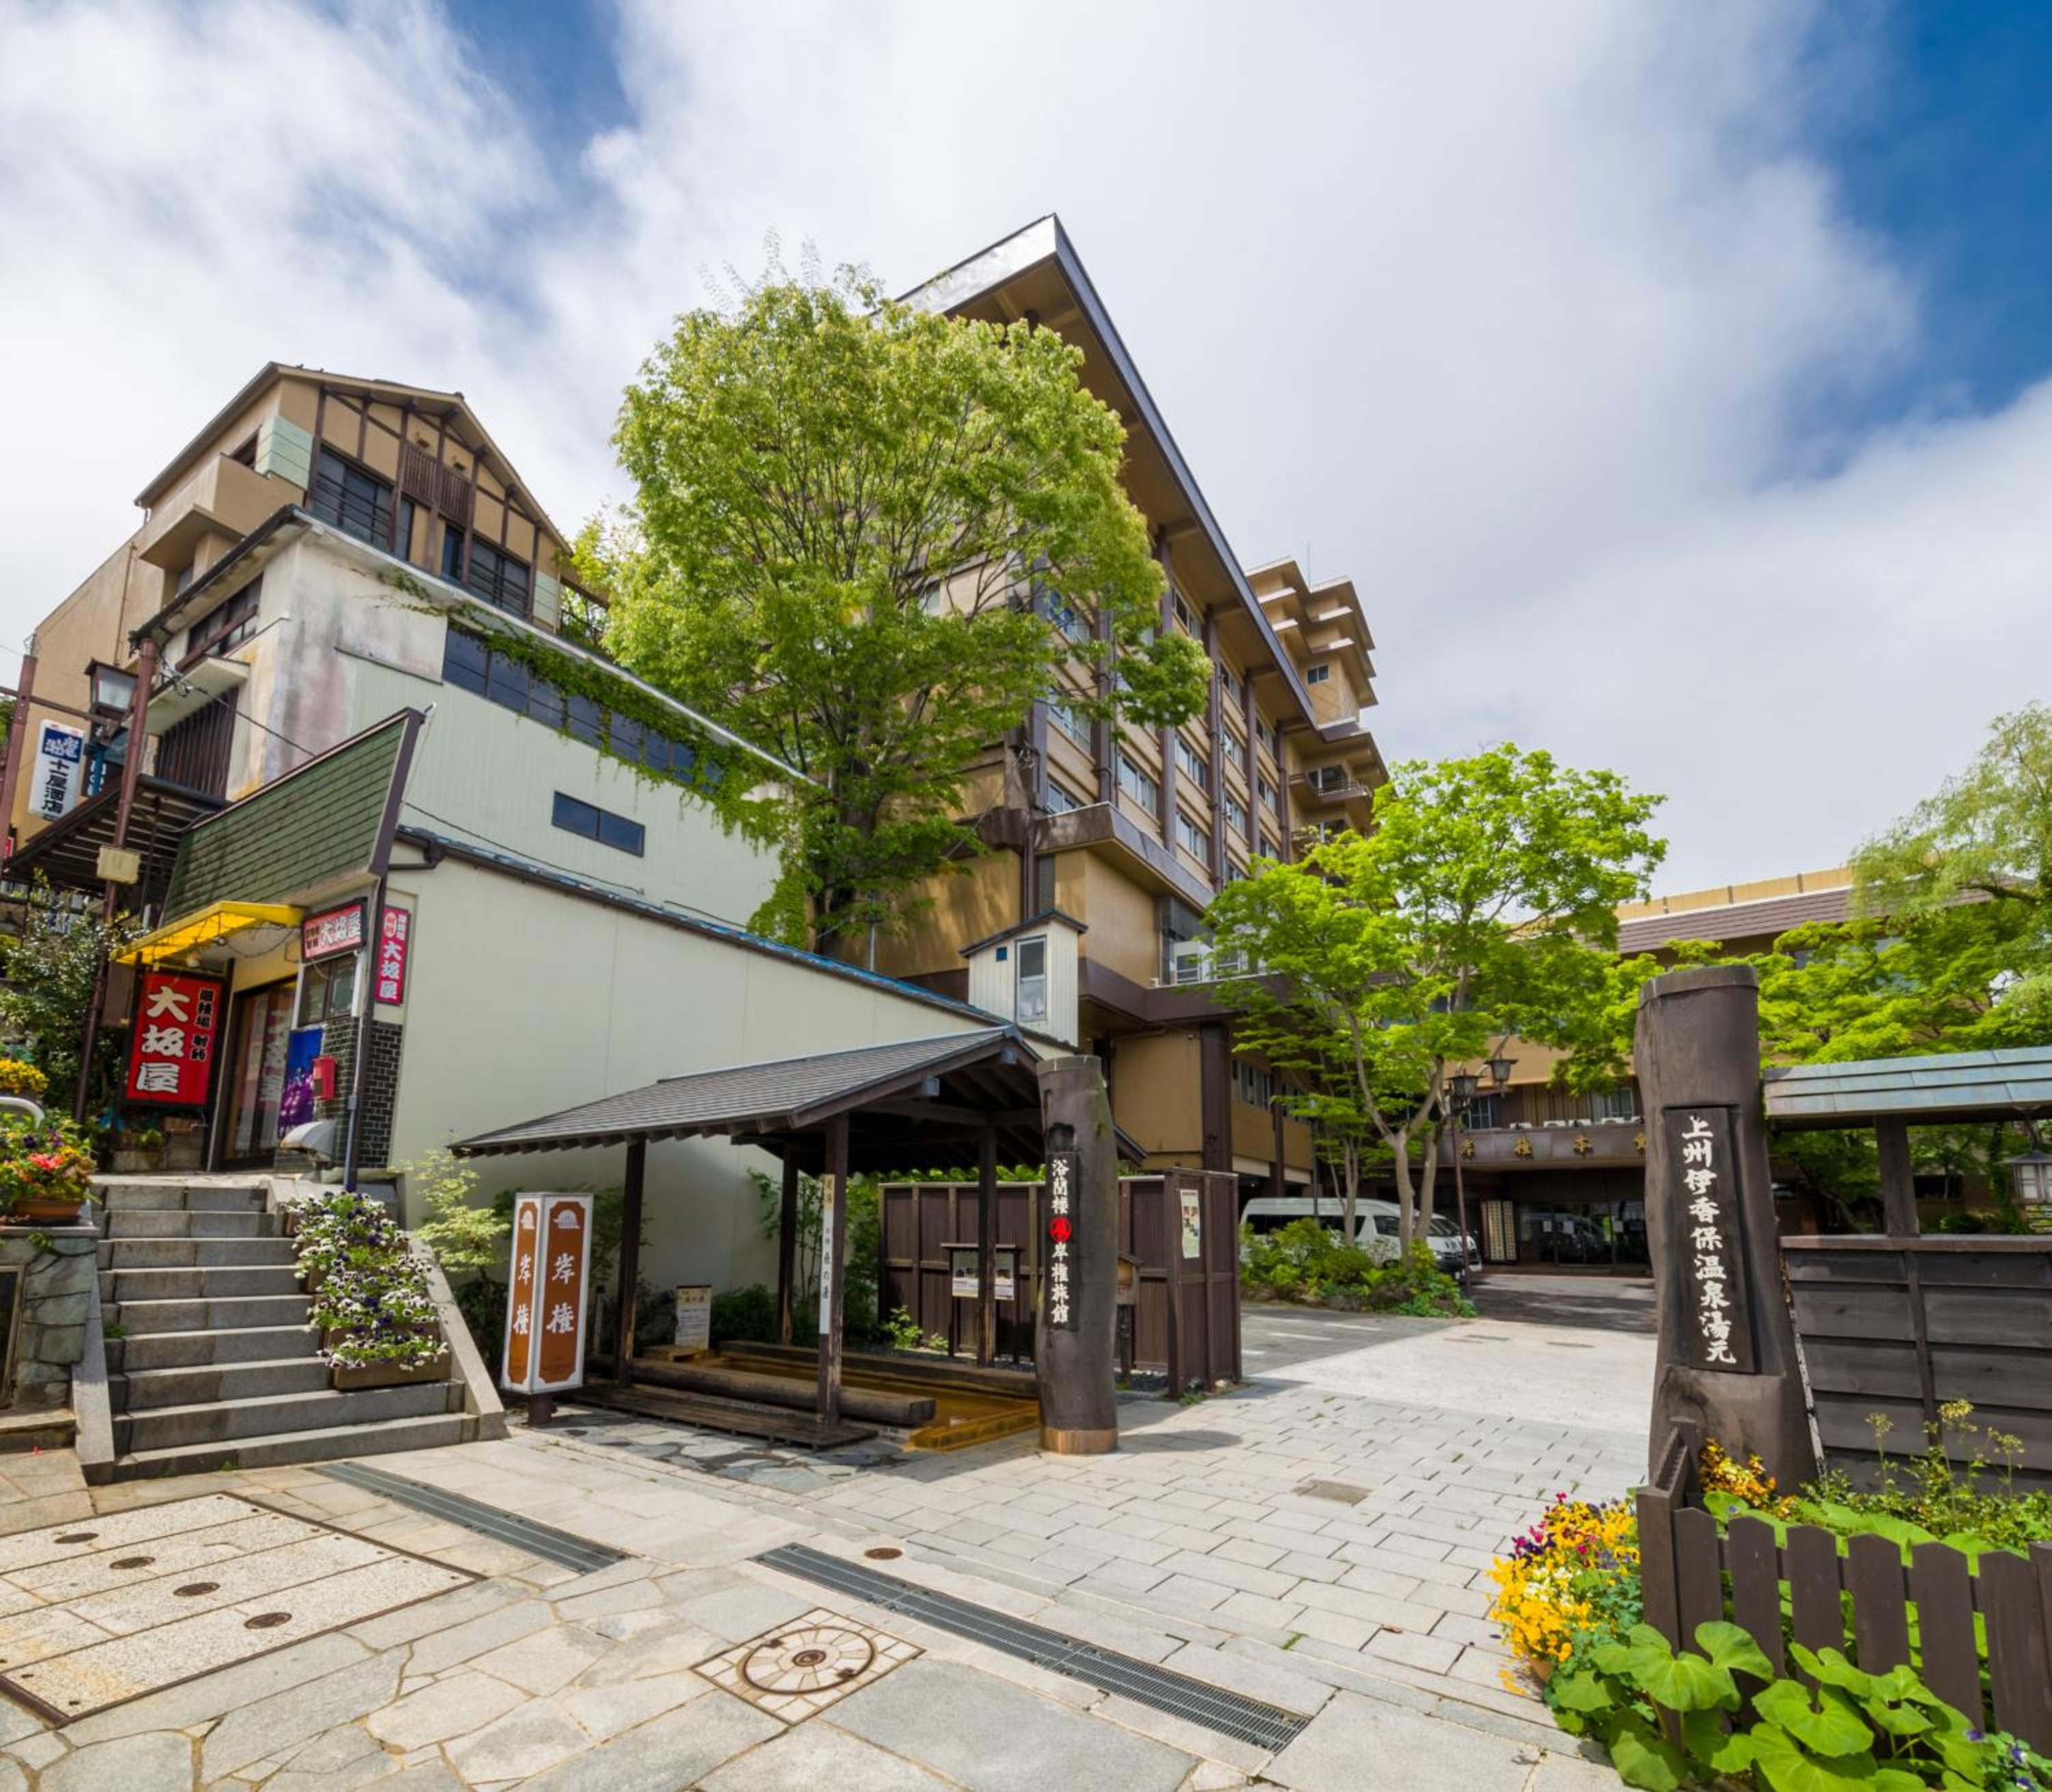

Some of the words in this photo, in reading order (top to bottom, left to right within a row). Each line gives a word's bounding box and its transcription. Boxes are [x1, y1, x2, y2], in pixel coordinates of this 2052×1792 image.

[41, 760, 70, 814] 十一屋酒店
[1681, 1116, 1737, 1364] 上州伊香保温泉湯元
